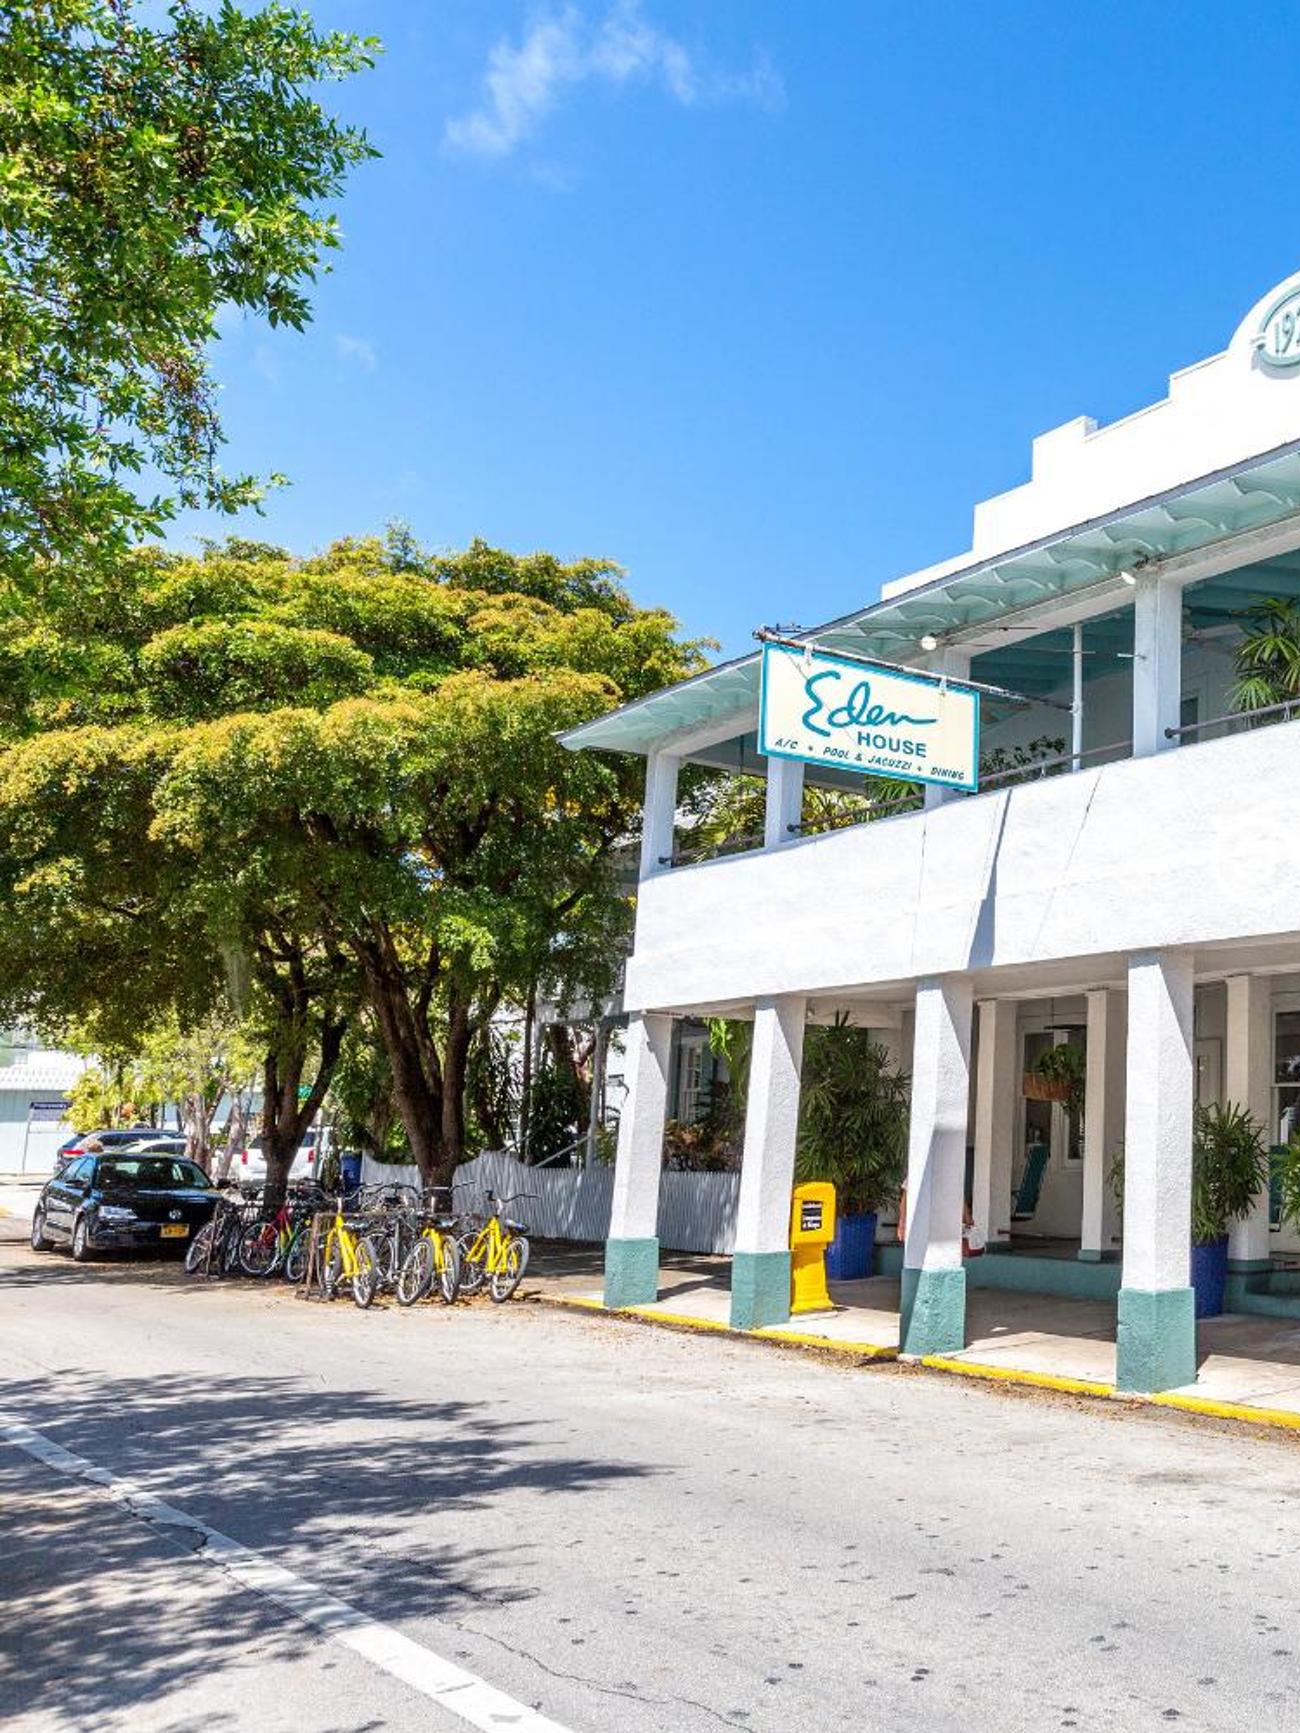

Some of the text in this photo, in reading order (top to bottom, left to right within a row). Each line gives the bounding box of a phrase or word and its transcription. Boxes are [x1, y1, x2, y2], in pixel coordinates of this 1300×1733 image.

[801, 670, 938, 738] Eden
[774, 738, 965, 781] A/C POOL & JACUZZI DINING
[857, 731, 927, 758] HOUSE
